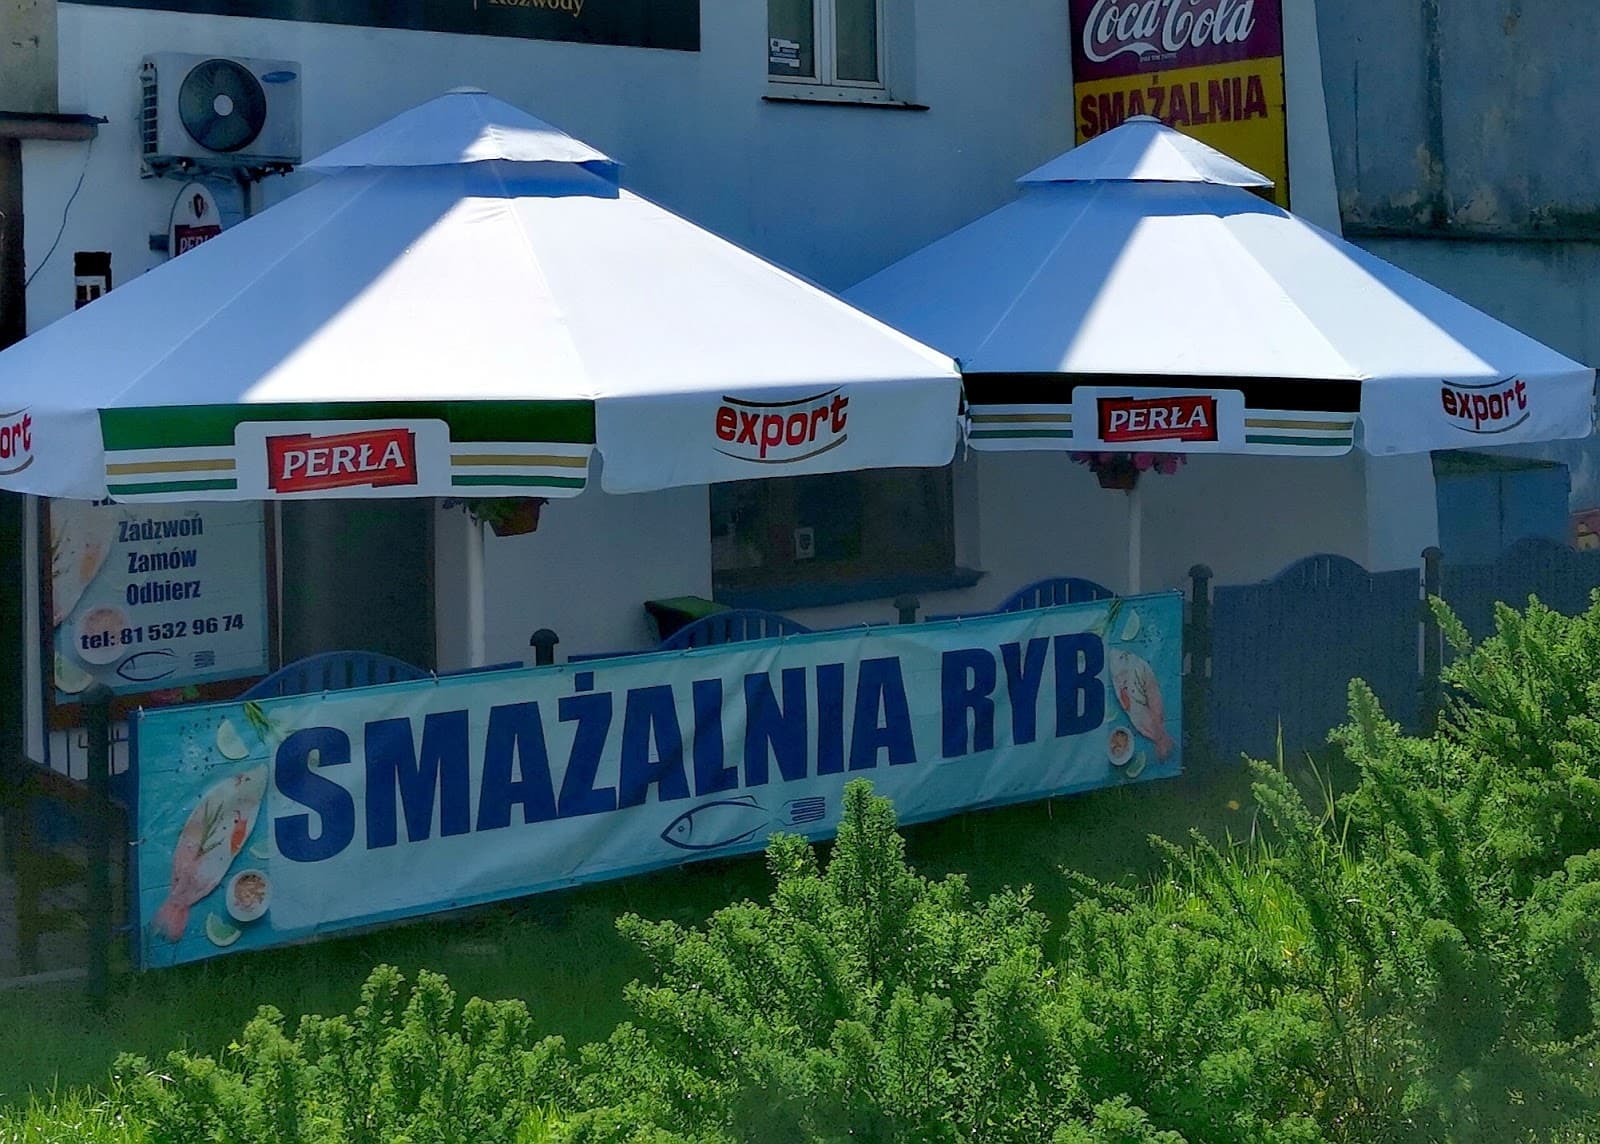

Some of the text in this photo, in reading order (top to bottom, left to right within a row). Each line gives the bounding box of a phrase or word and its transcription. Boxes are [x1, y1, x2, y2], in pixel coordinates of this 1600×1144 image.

[1080, 75, 1268, 138] SMAŻALNIA
[1108, 405, 1209, 433] PERŁA
[1441, 379, 1527, 430] export
[0, 413, 32, 459] ort
[716, 394, 849, 459] export
[282, 440, 406, 480] PERŁA
[118, 513, 204, 543] Zadzwoń
[128, 546, 197, 574] Zamów
[126, 579, 202, 606] Odbierz
[81, 613, 244, 650] tel: 81 532 96 74
[273, 631, 1106, 864] SMAŻALNIA RYB
